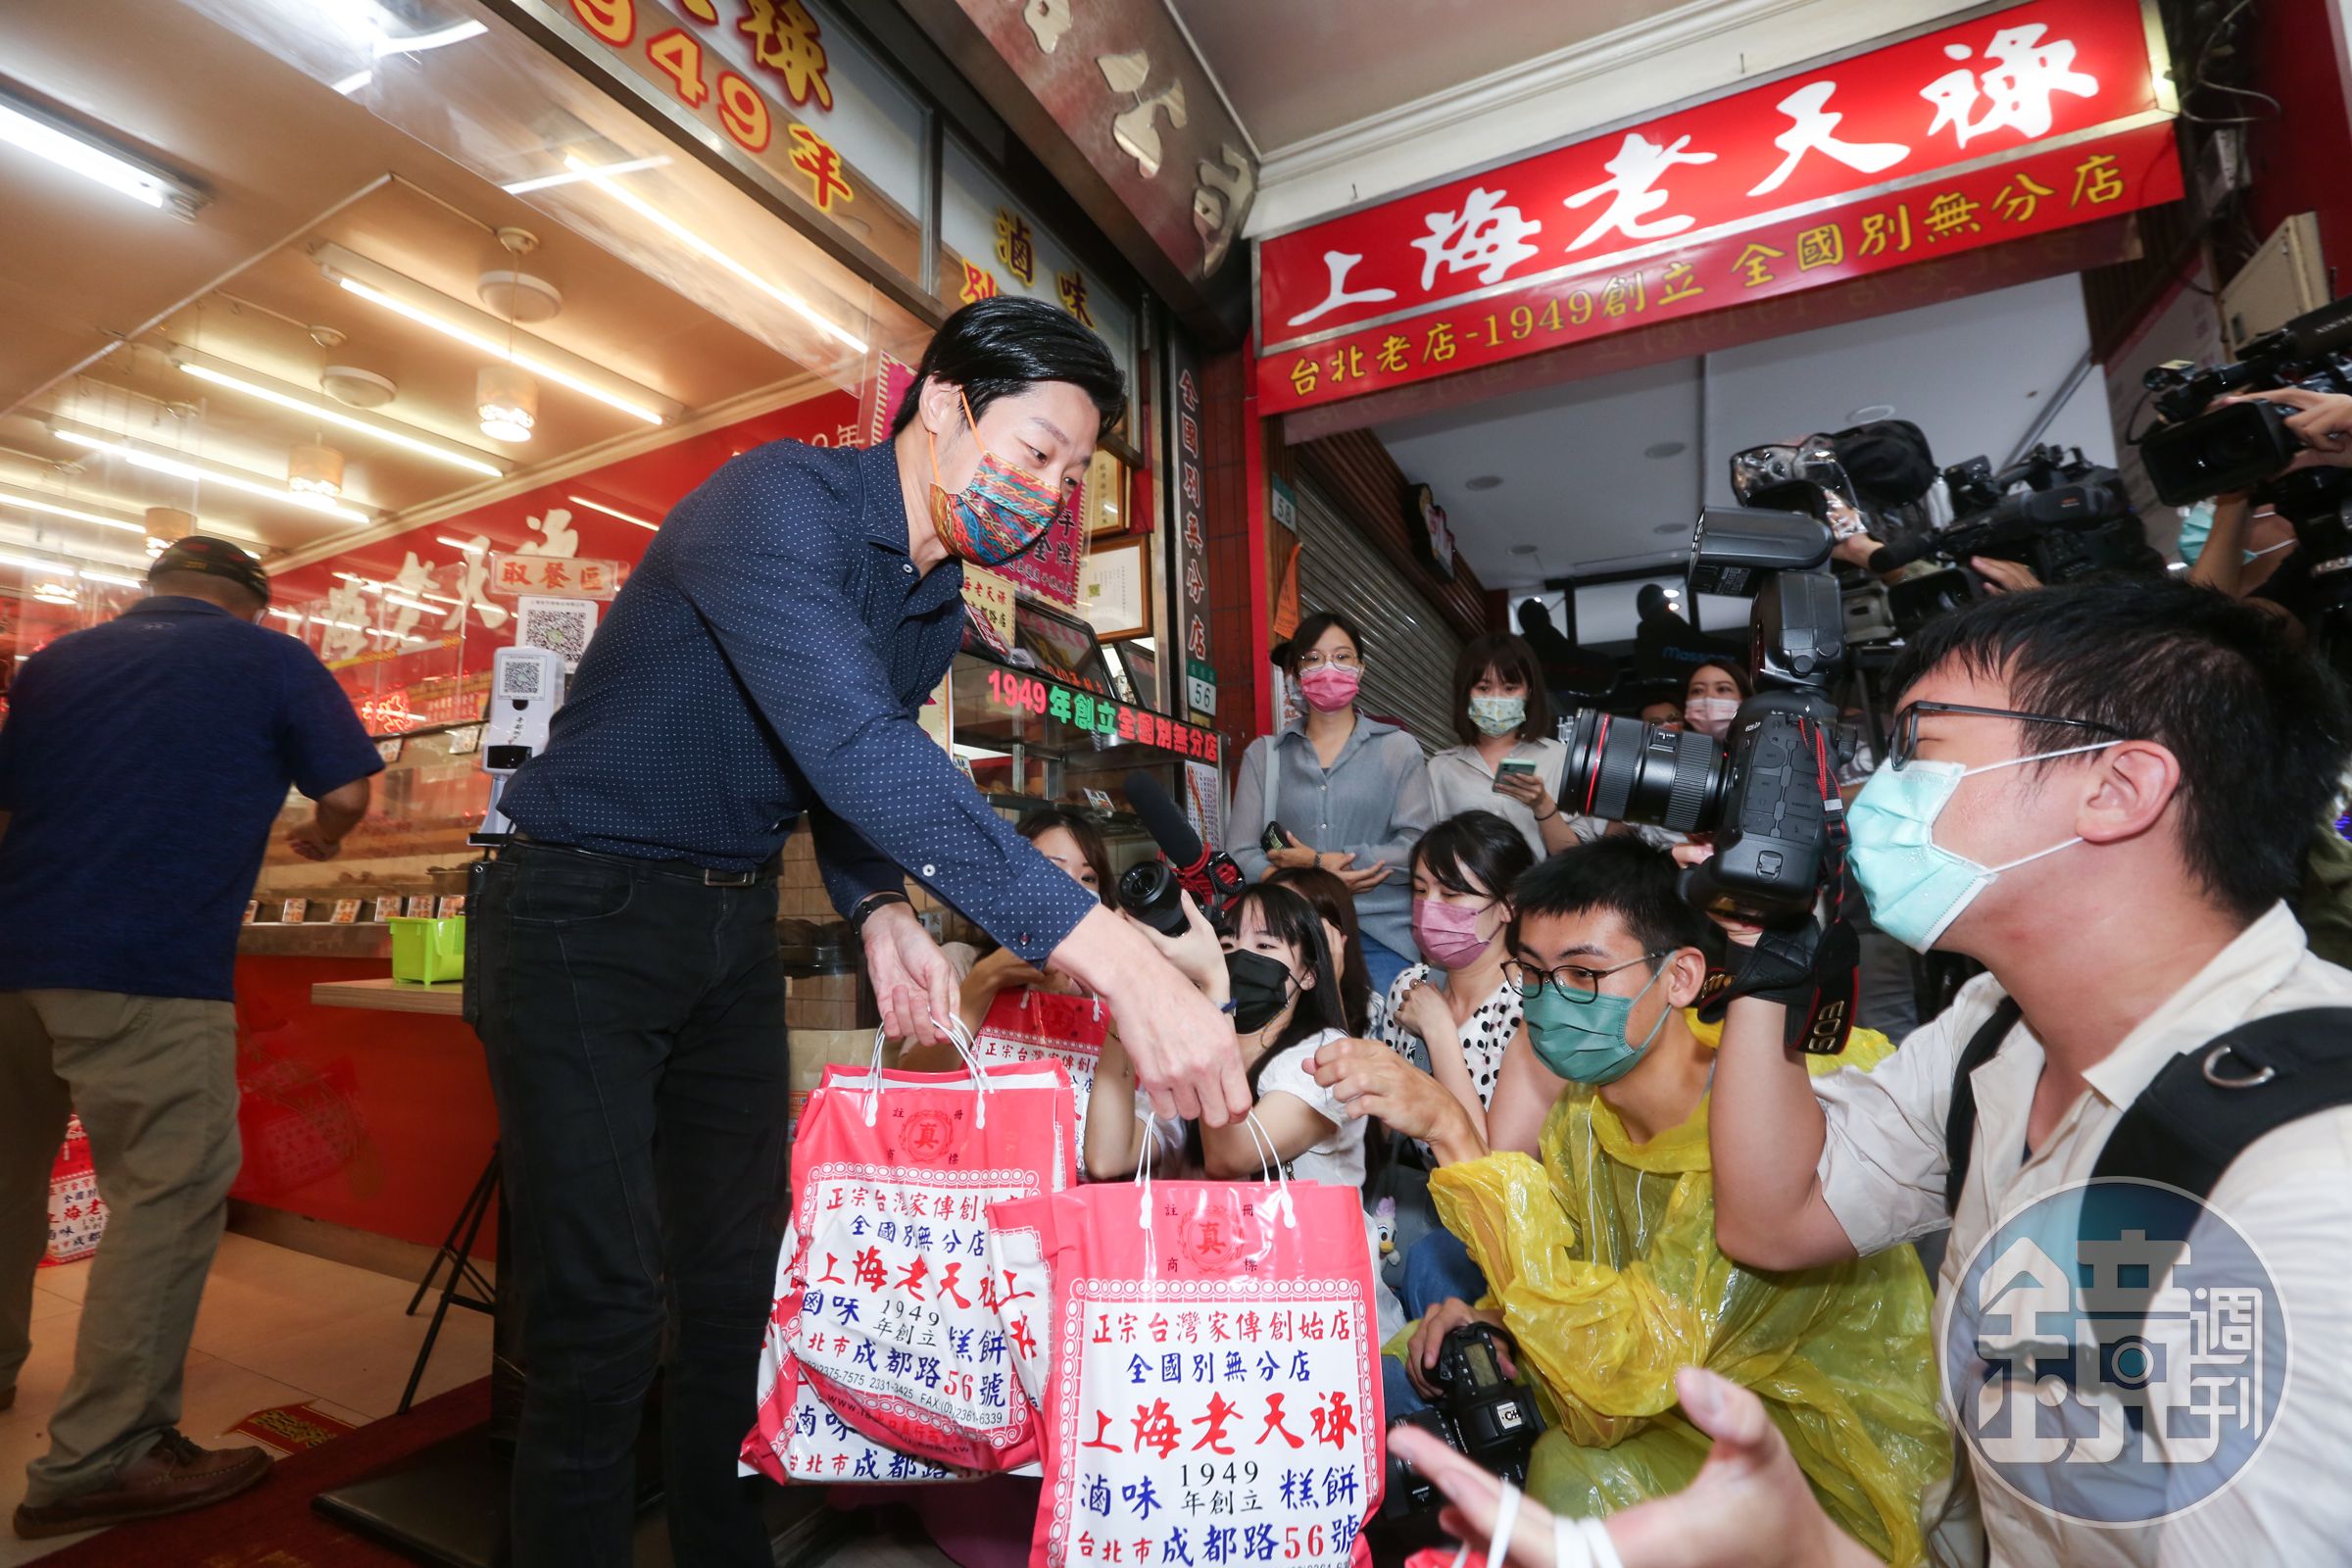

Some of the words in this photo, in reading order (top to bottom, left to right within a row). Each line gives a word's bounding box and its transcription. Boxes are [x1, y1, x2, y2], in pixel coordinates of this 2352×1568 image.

[1288, 22, 2099, 327] 上海老天祿
[1732, 154, 2127, 288] 全國別無分店
[501, 562, 604, 591] 取餐區
[1195, 682, 1211, 710] 56
[913, 1123, 939, 1149] 真
[1197, 1222, 1226, 1255] 真
[881, 1299, 941, 1328] 1949
[1092, 1309, 1351, 1344] 正宗台灣家傳創始店
[873, 1316, 937, 1348] 年創立
[806, 1332, 1006, 1408] 北市成都路56號
[1126, 1349, 1312, 1385] 全國別無分店
[869, 1377, 913, 1398] 2331-3425
[1081, 1391, 1358, 1460] 上海老天祿
[1179, 1460, 1259, 1488] 1949
[1080, 1472, 1162, 1521] 滷味
[1279, 1463, 1360, 1511] 糕餅
[1180, 1489, 1263, 1518] 年創立
